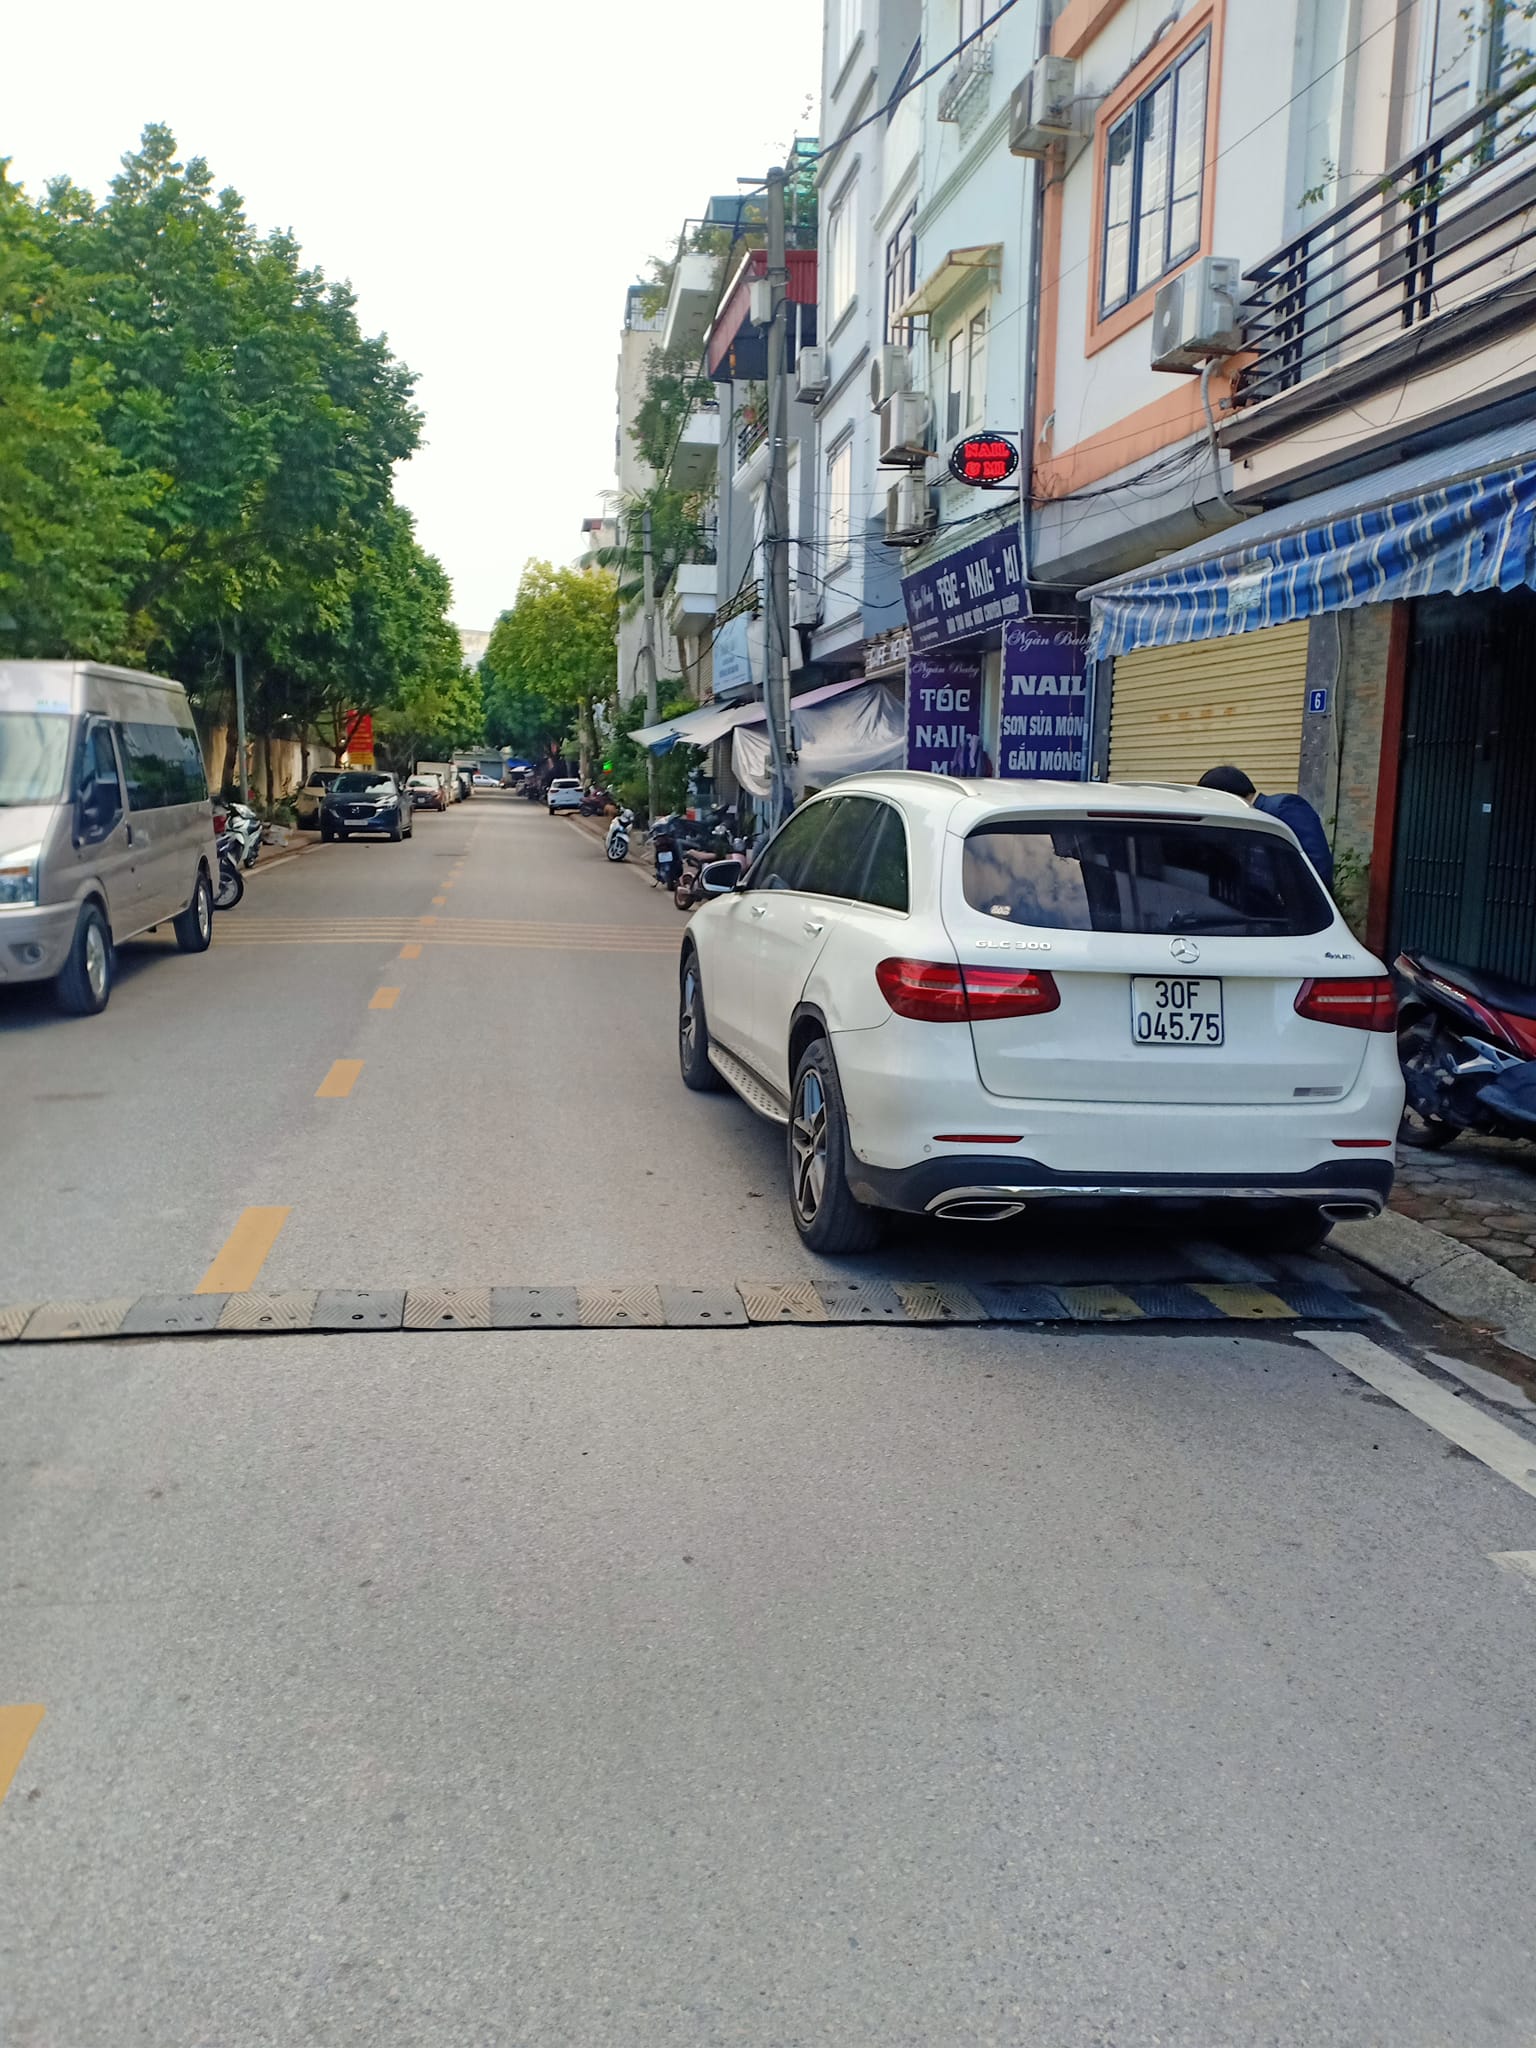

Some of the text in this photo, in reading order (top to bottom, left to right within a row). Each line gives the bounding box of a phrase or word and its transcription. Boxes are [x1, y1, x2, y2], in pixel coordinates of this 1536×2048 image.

[965, 442, 1010, 458] NAIL
[983, 461, 1006, 476] MI
[936, 567, 960, 611] TÓC
[965, 557, 995, 600] NAIL
[1002, 544, 1020, 586] MI
[1011, 675, 1087, 696] NAIL
[920, 683, 971, 712] TÓC
[1315, 692, 1322, 709] 6
[975, 940, 1051, 951] GLC 300
[1155, 980, 1200, 1009] 30F
[1137, 1012, 1219, 1041] 045.75
